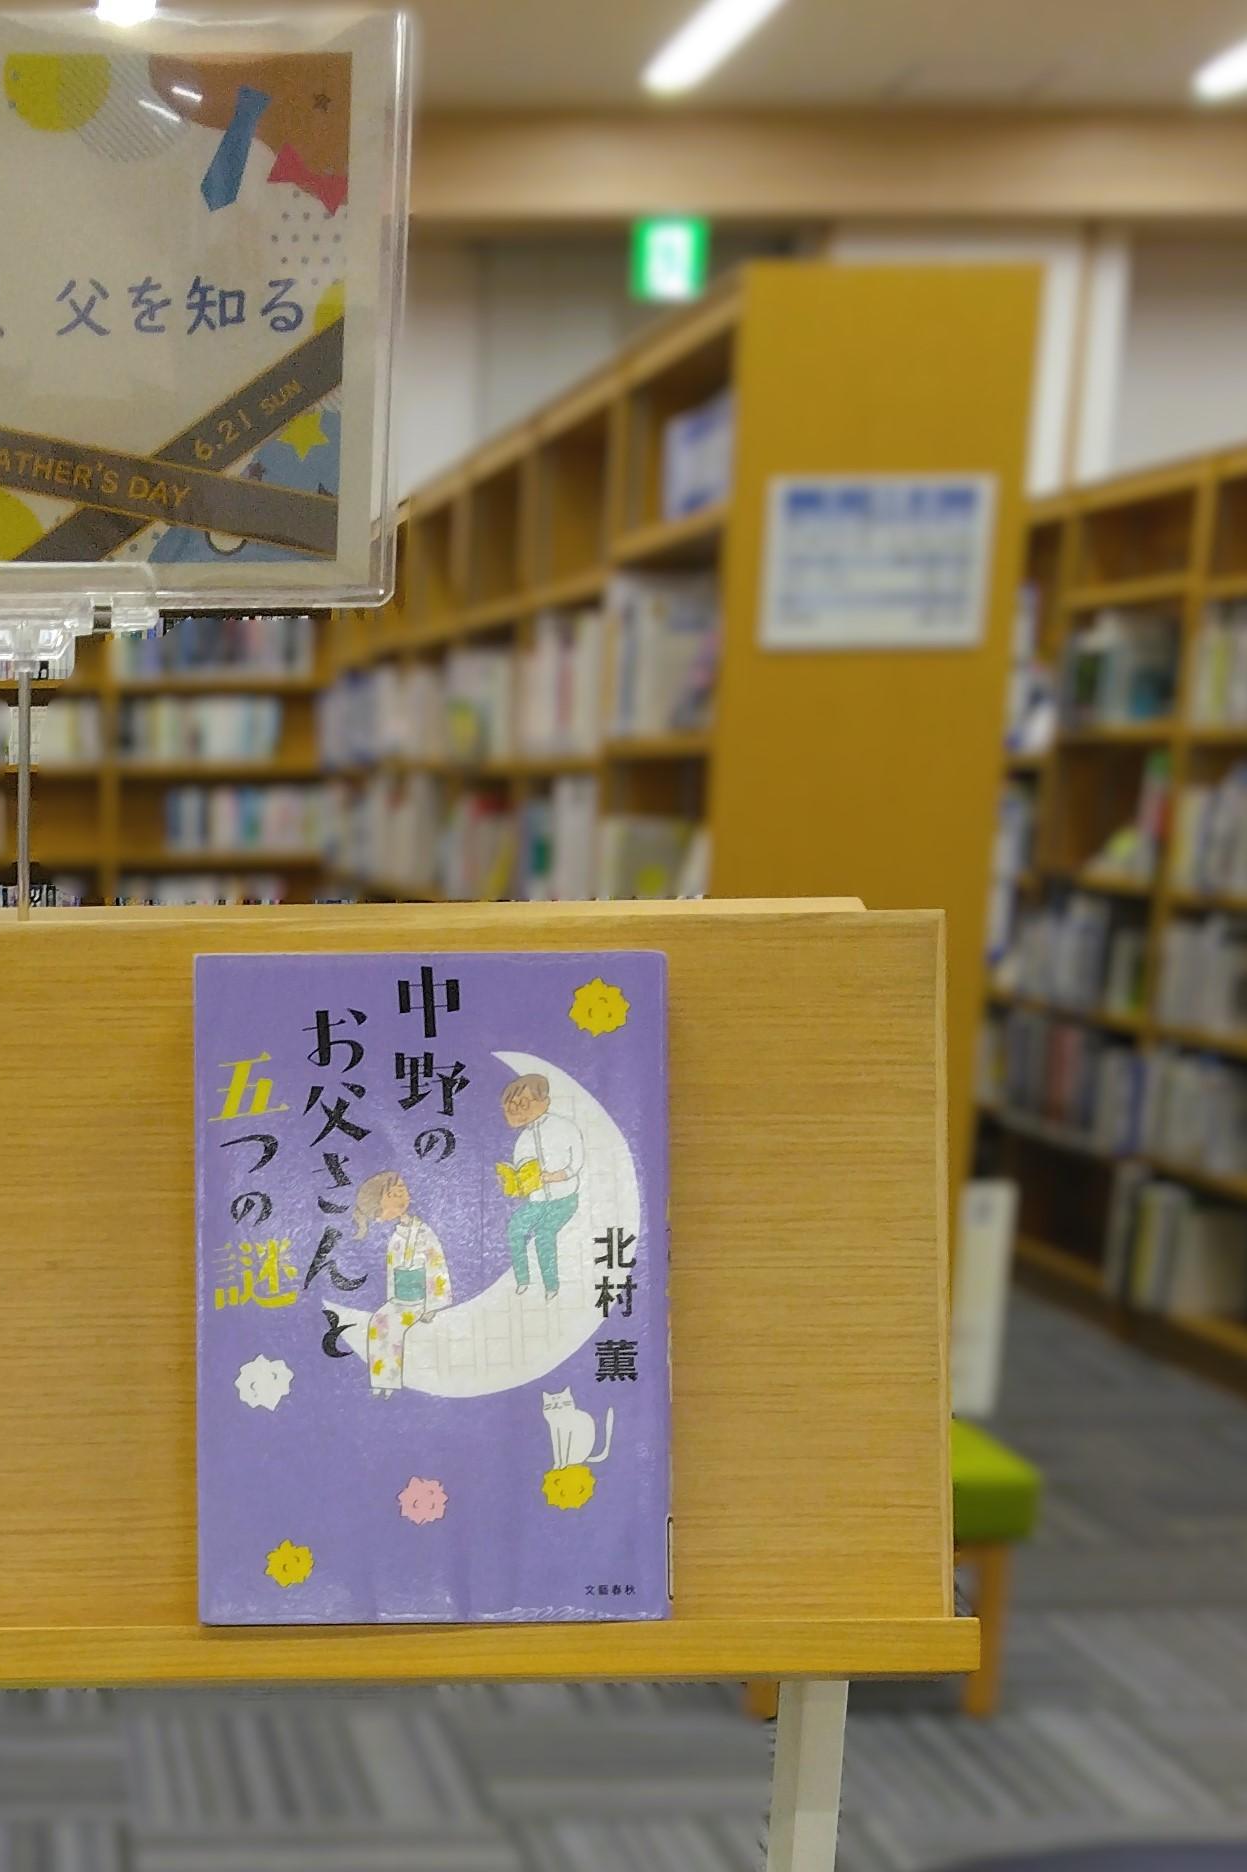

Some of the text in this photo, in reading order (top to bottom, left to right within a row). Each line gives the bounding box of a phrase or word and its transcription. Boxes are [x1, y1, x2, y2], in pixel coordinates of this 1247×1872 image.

[127, 473, 193, 509] DAY
[193, 378, 303, 461] 6.21 SUN
[395, 966, 470, 1162] 中野の
[208, 1051, 300, 1311] 五つの謎
[303, 1007, 372, 1359] お父さんと
[594, 1227, 639, 1383] 北村薫
[584, 1584, 636, 1596] 文藝春秋
